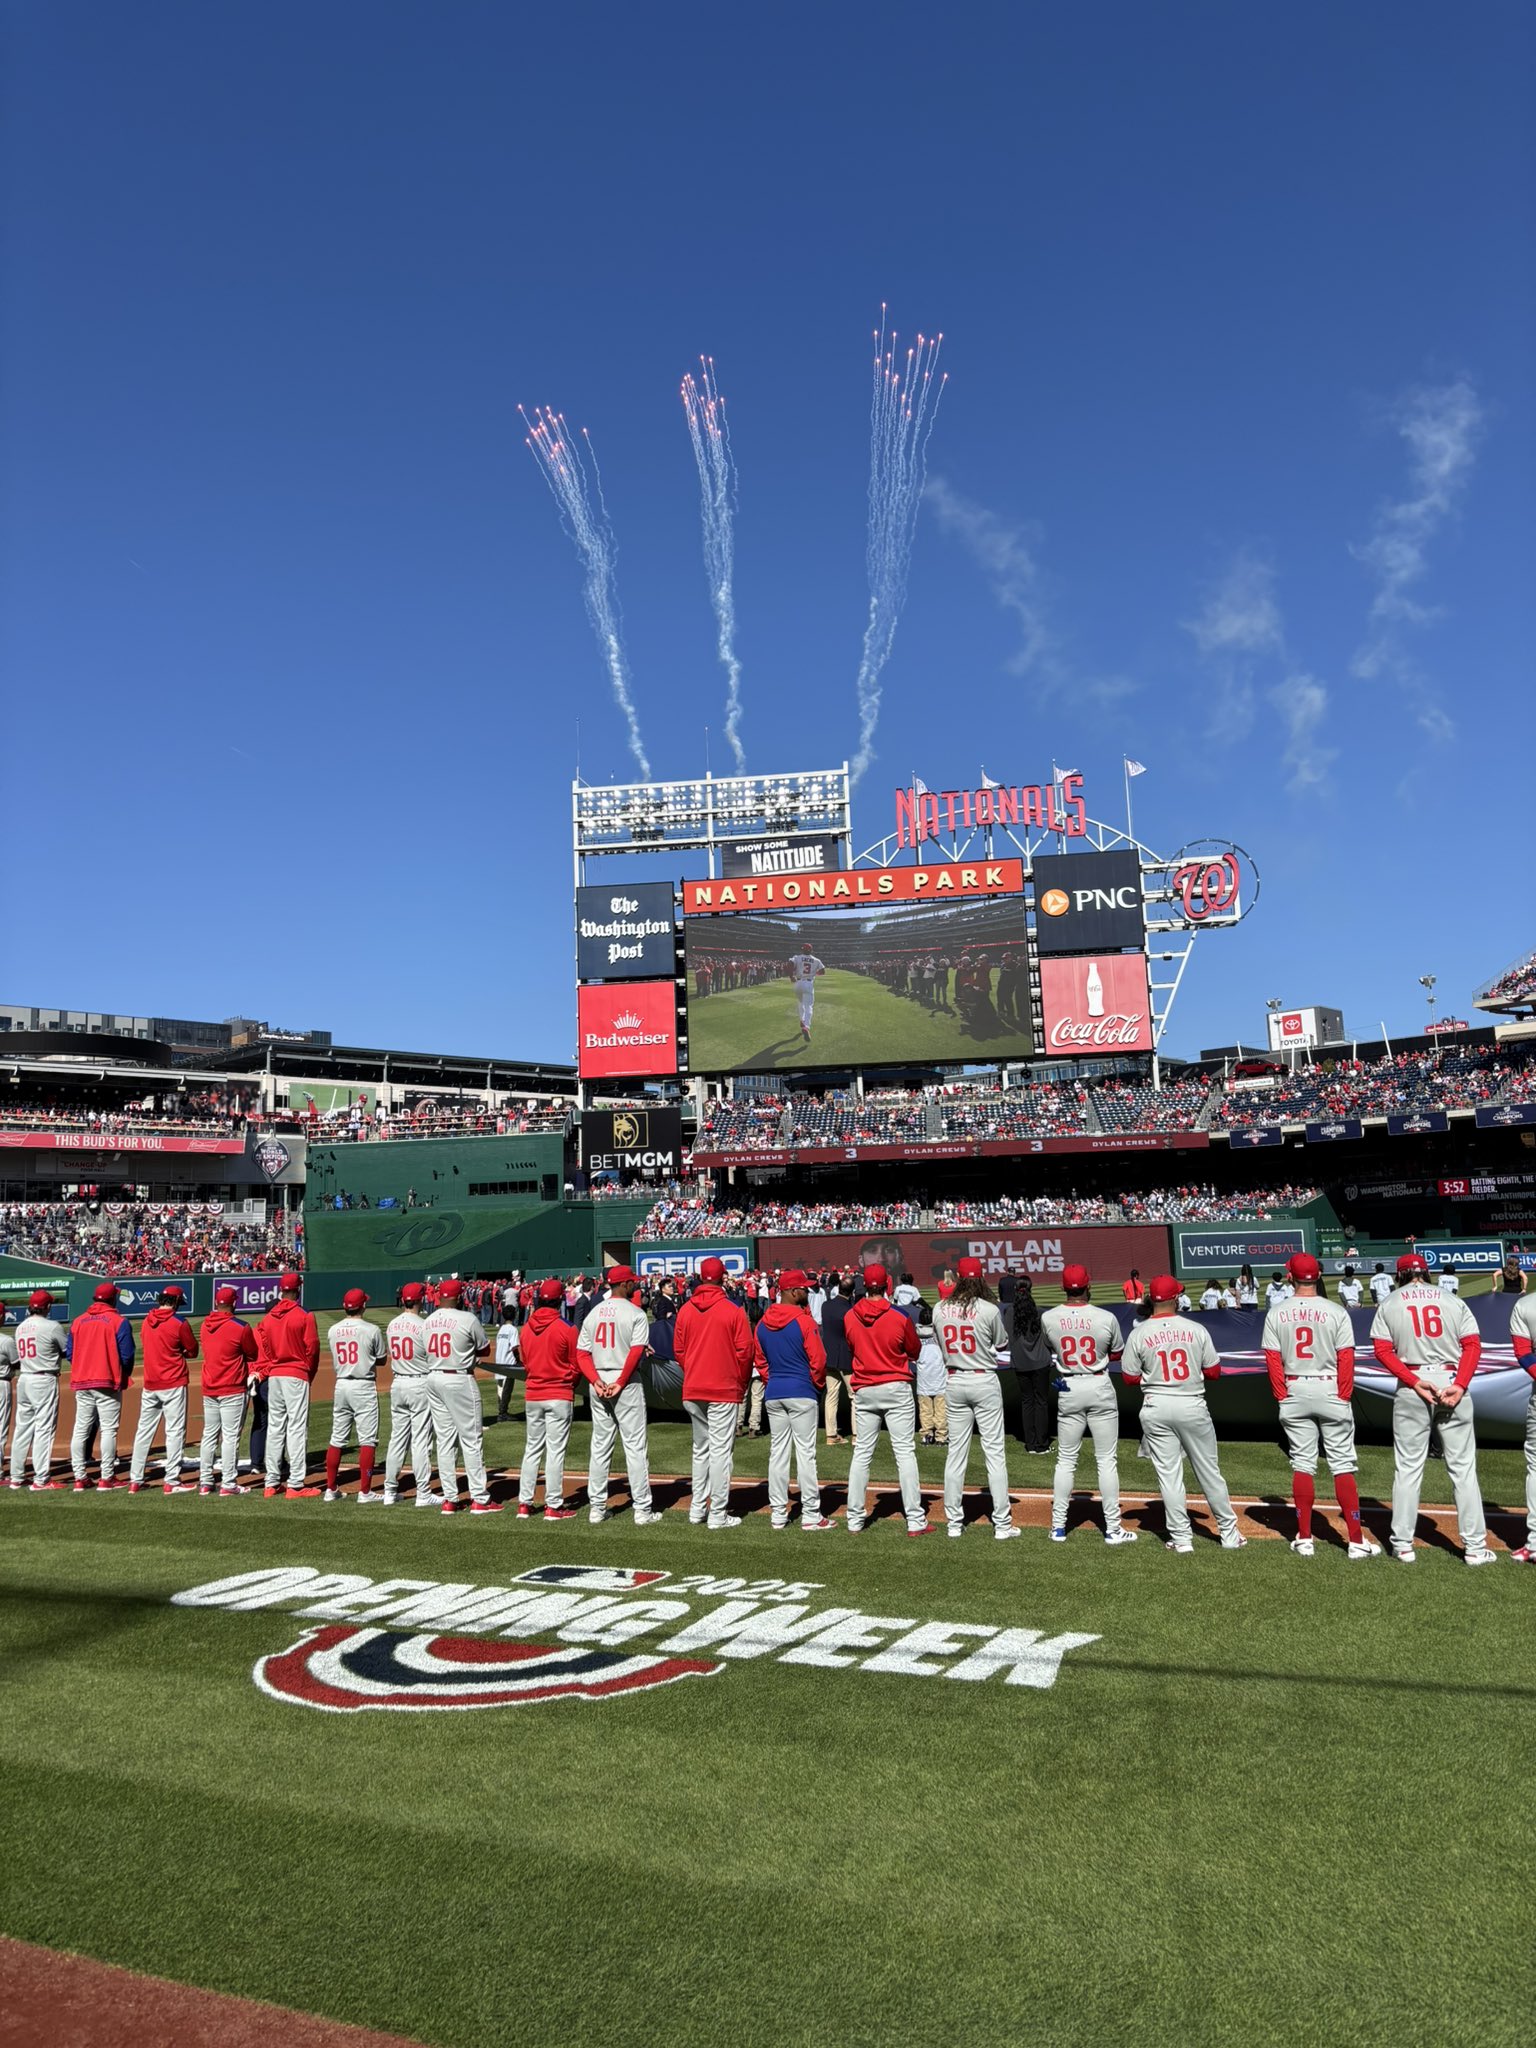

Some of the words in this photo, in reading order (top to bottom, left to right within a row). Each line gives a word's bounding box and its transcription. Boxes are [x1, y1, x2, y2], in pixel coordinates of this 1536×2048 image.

[896, 774, 1086, 849] NATIONALS
[736, 844, 762, 853] SHOW
[764, 840, 788, 850] SOME
[750, 845, 824, 873] NATITUDE
[696, 874, 894, 906] NATIONALS
[913, 866, 1004, 891] PARK
[610, 896, 638, 915] The
[1072, 886, 1138, 912] PNC
[580, 918, 671, 940] Washington
[608, 942, 644, 964] Post
[585, 1032, 669, 1048] Budweiser
[1050, 1014, 1144, 1047] Coca-Cola
[54, 1134, 80, 1146] THIS
[83, 1136, 116, 1148] BUD'S
[118, 1136, 138, 1148] FOR
[140, 1138, 165, 1149] YOU.
[1030, 1140, 1043, 1151] 3
[590, 1151, 673, 1170] BETMGM
[845, 1148, 857, 1159] 3
[1360, 1183, 1406, 1195] WASHINGTON
[1444, 1181, 1464, 1194] 3:52
[1471, 1178, 1496, 1186] BATTING
[1383, 1186, 1423, 1198] NATIONALS
[1452, 1194, 1484, 1202] NATIONALS
[1491, 1210, 1536, 1220] network
[1501, 1202, 1522, 1211] The
[968, 1239, 1061, 1257] DYLAN
[1188, 1245, 1246, 1256] VENTURE
[1248, 1244, 1297, 1255] GLOBAL
[1440, 1252, 1500, 1263] DABOS
[243, 1285, 283, 1304] leid
[1401, 1290, 1441, 1300] MARSH
[1060, 1318, 1092, 1331] ROJAS
[1279, 1309, 1328, 1324] CLEMENS
[1407, 1305, 1443, 1338] 16
[428, 1332, 451, 1358] 46
[595, 1322, 615, 1349] 41
[943, 1324, 976, 1354] 25
[1145, 1330, 1194, 1348] MARCHAN
[1295, 1326, 1314, 1359] 2
[18, 1338, 37, 1359] 95
[336, 1341, 358, 1365] 58
[390, 1336, 414, 1360] 50
[1061, 1336, 1096, 1366] 23
[1157, 1349, 1190, 1382] 13
[656, 1574, 826, 1600] 2025
[170, 1566, 690, 1646] OPENING
[656, 1600, 1104, 1689] WEEK
